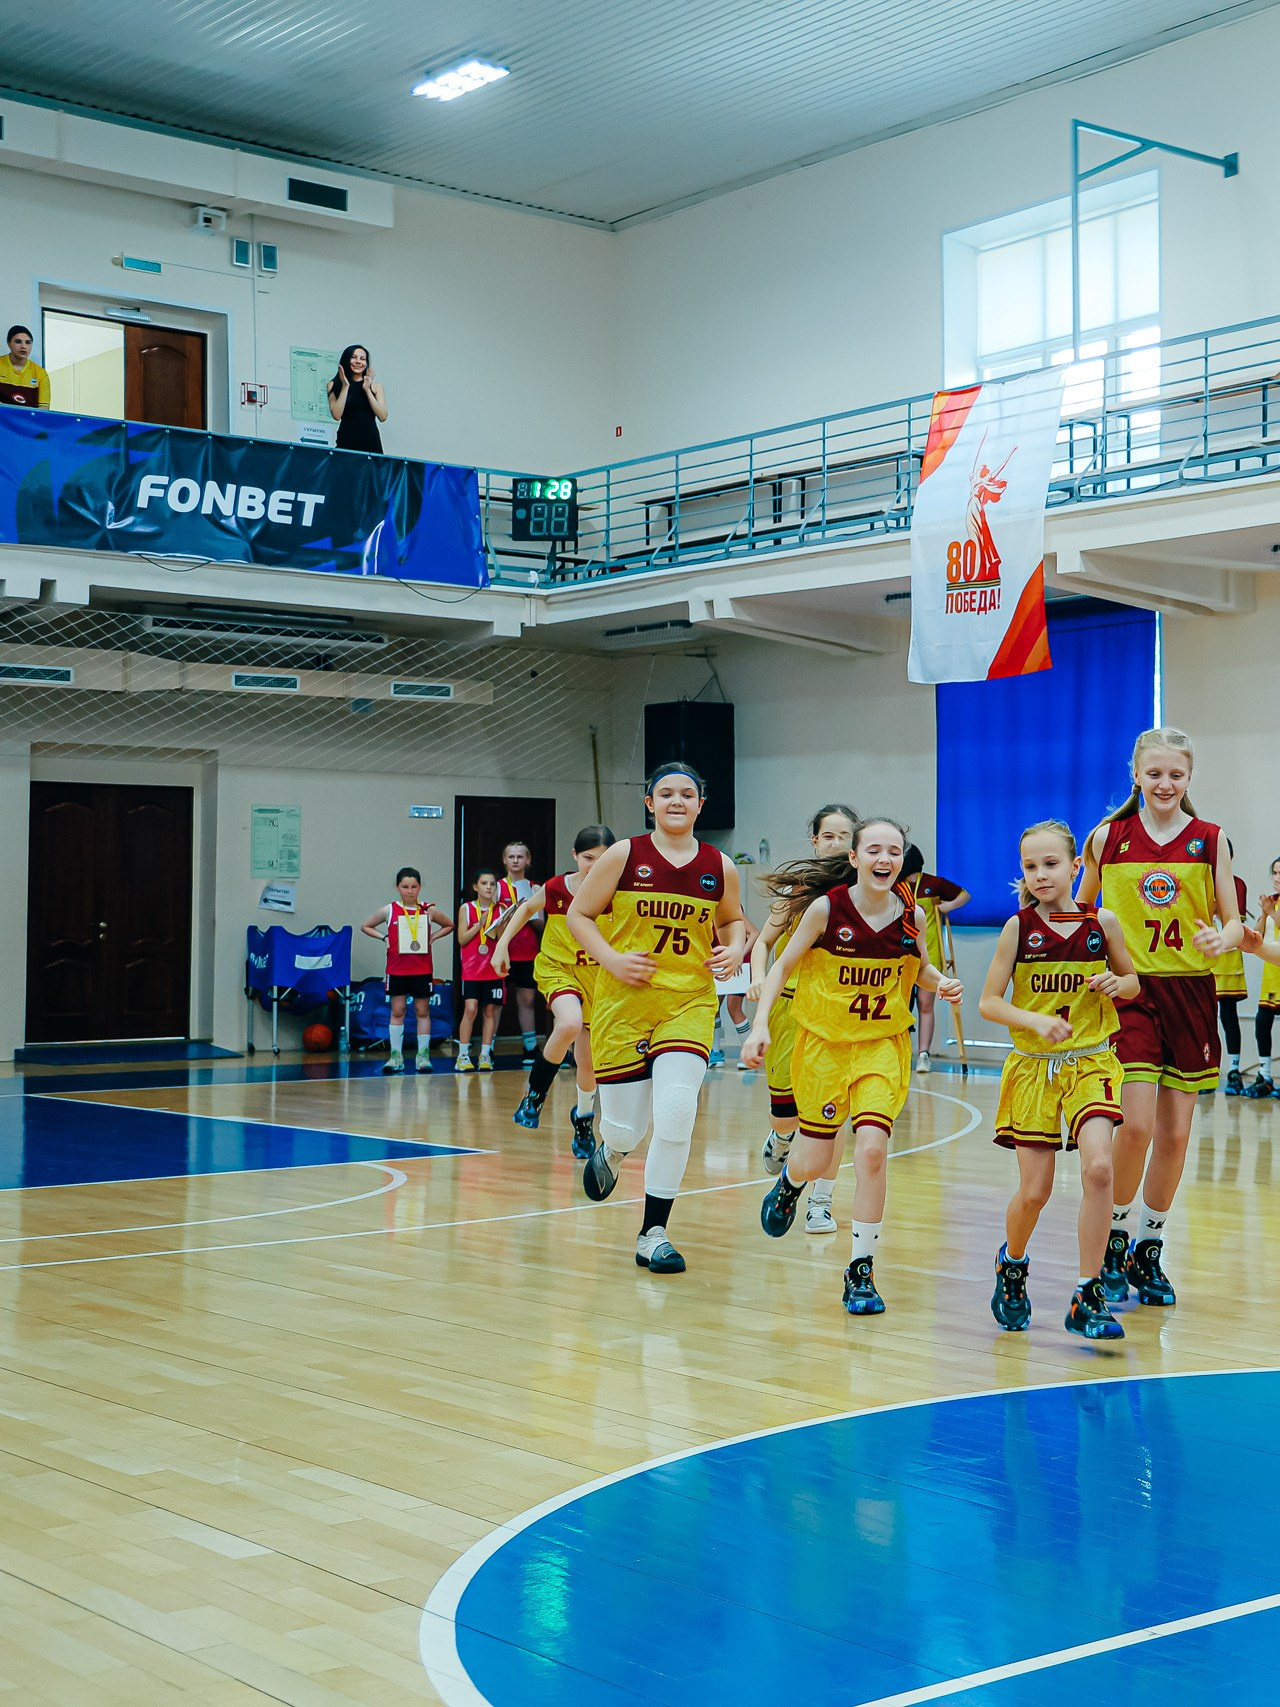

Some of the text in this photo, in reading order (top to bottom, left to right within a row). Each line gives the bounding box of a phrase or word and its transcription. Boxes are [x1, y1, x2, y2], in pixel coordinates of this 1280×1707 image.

[137, 474, 326, 527] FONBET
[946, 539, 977, 583] 80
[945, 587, 1001, 616] ПОБЕДА!
[636, 900, 711, 924] СШОР 5
[653, 925, 691, 956] 75
[1144, 919, 1184, 953] 74
[838, 965, 892, 987] СШОР
[1031, 973, 1085, 993] СШОР
[492, 988, 503, 999] 10
[849, 993, 891, 1021] 42
